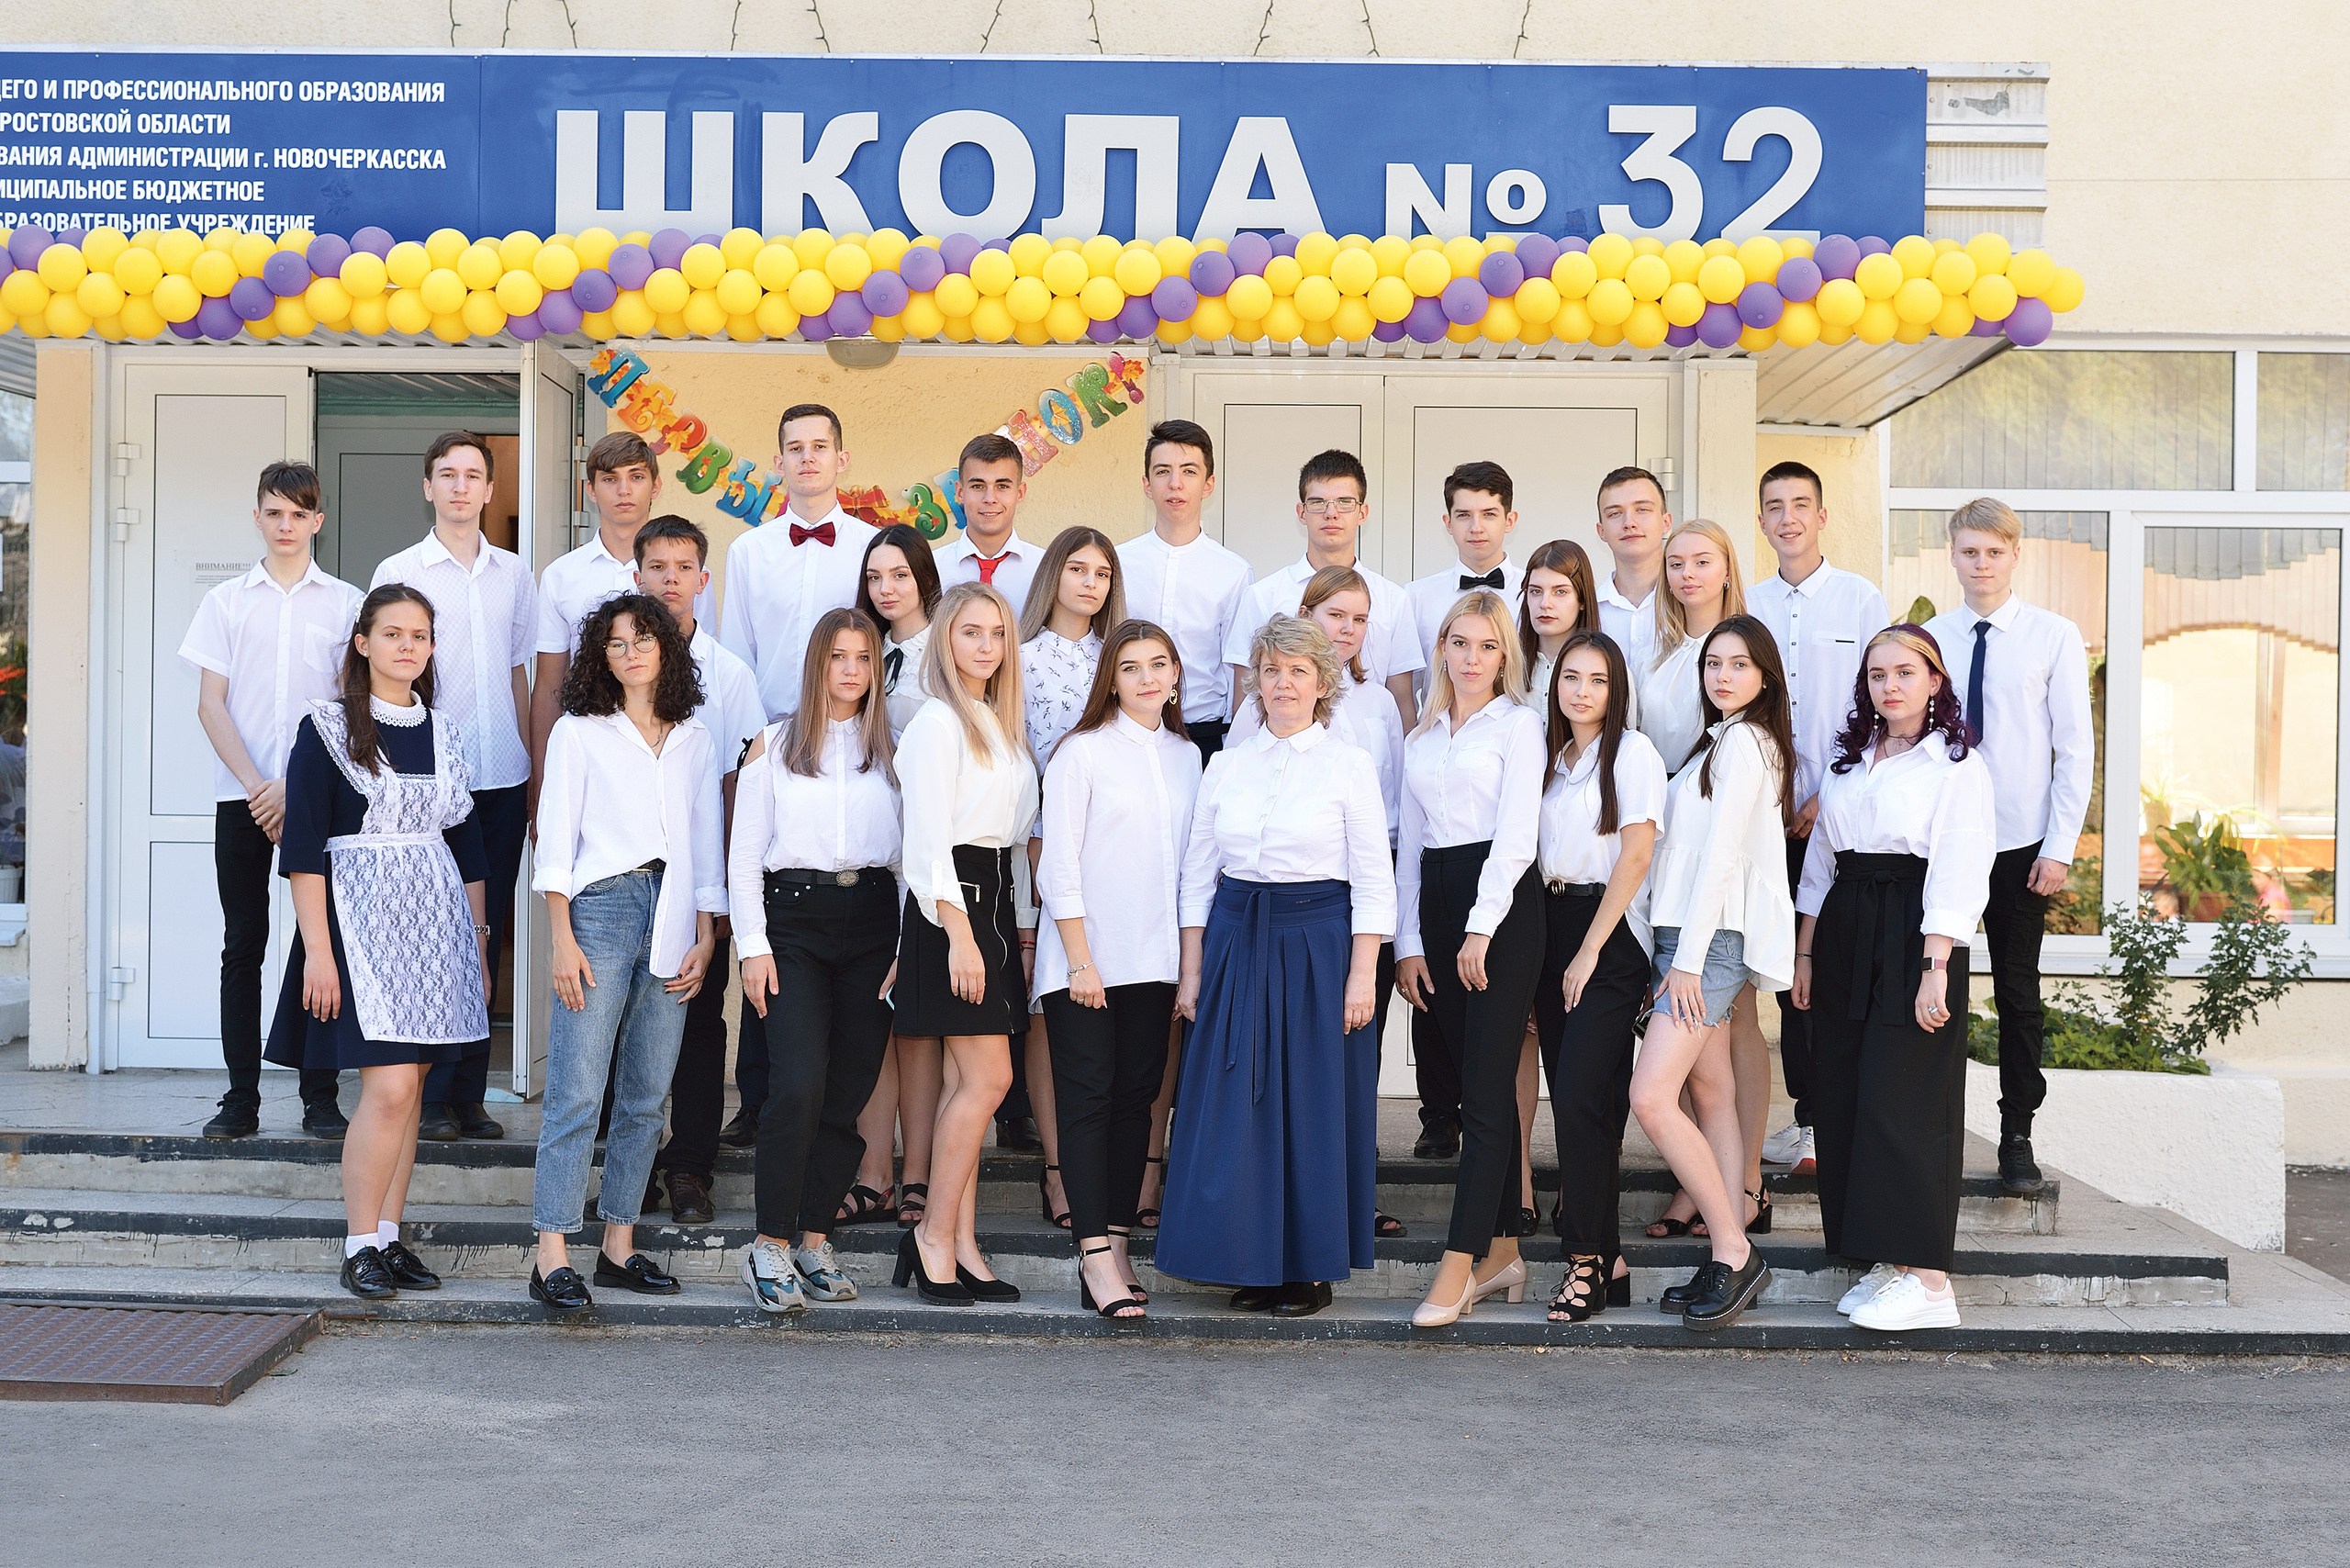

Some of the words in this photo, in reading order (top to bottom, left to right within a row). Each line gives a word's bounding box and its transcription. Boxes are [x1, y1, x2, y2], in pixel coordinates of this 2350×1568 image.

[0, 79, 38, 102] ЕГО
[44, 80, 57, 99] И
[63, 80, 293, 102] ПРОФЕССИОНАЛЬНОГО
[299, 82, 445, 103] ОБРАЗОВАНИЯ
[0, 108, 131, 133] РОСТОВСКОЙ
[138, 114, 231, 135] ОБЛАСТИ
[68, 147, 249, 171] АДМИНИСТРАЦИИ
[254, 151, 268, 169] г.
[274, 149, 446, 170] НОВОЧЕРКАССКА
[555, 109, 1327, 241] ШКОЛА
[1597, 104, 1823, 241] 32
[132, 181, 265, 203] БЮДЖЕТНОЕ
[0, 212, 172, 233] РАЗОВАТЕЛЬНОЕ
[177, 214, 316, 235] УЧРЕЖДЕНИЕ
[587, 348, 789, 528] ПЕРВЫ
[196, 562, 252, 572] ВНИМАНИЕ!!!
